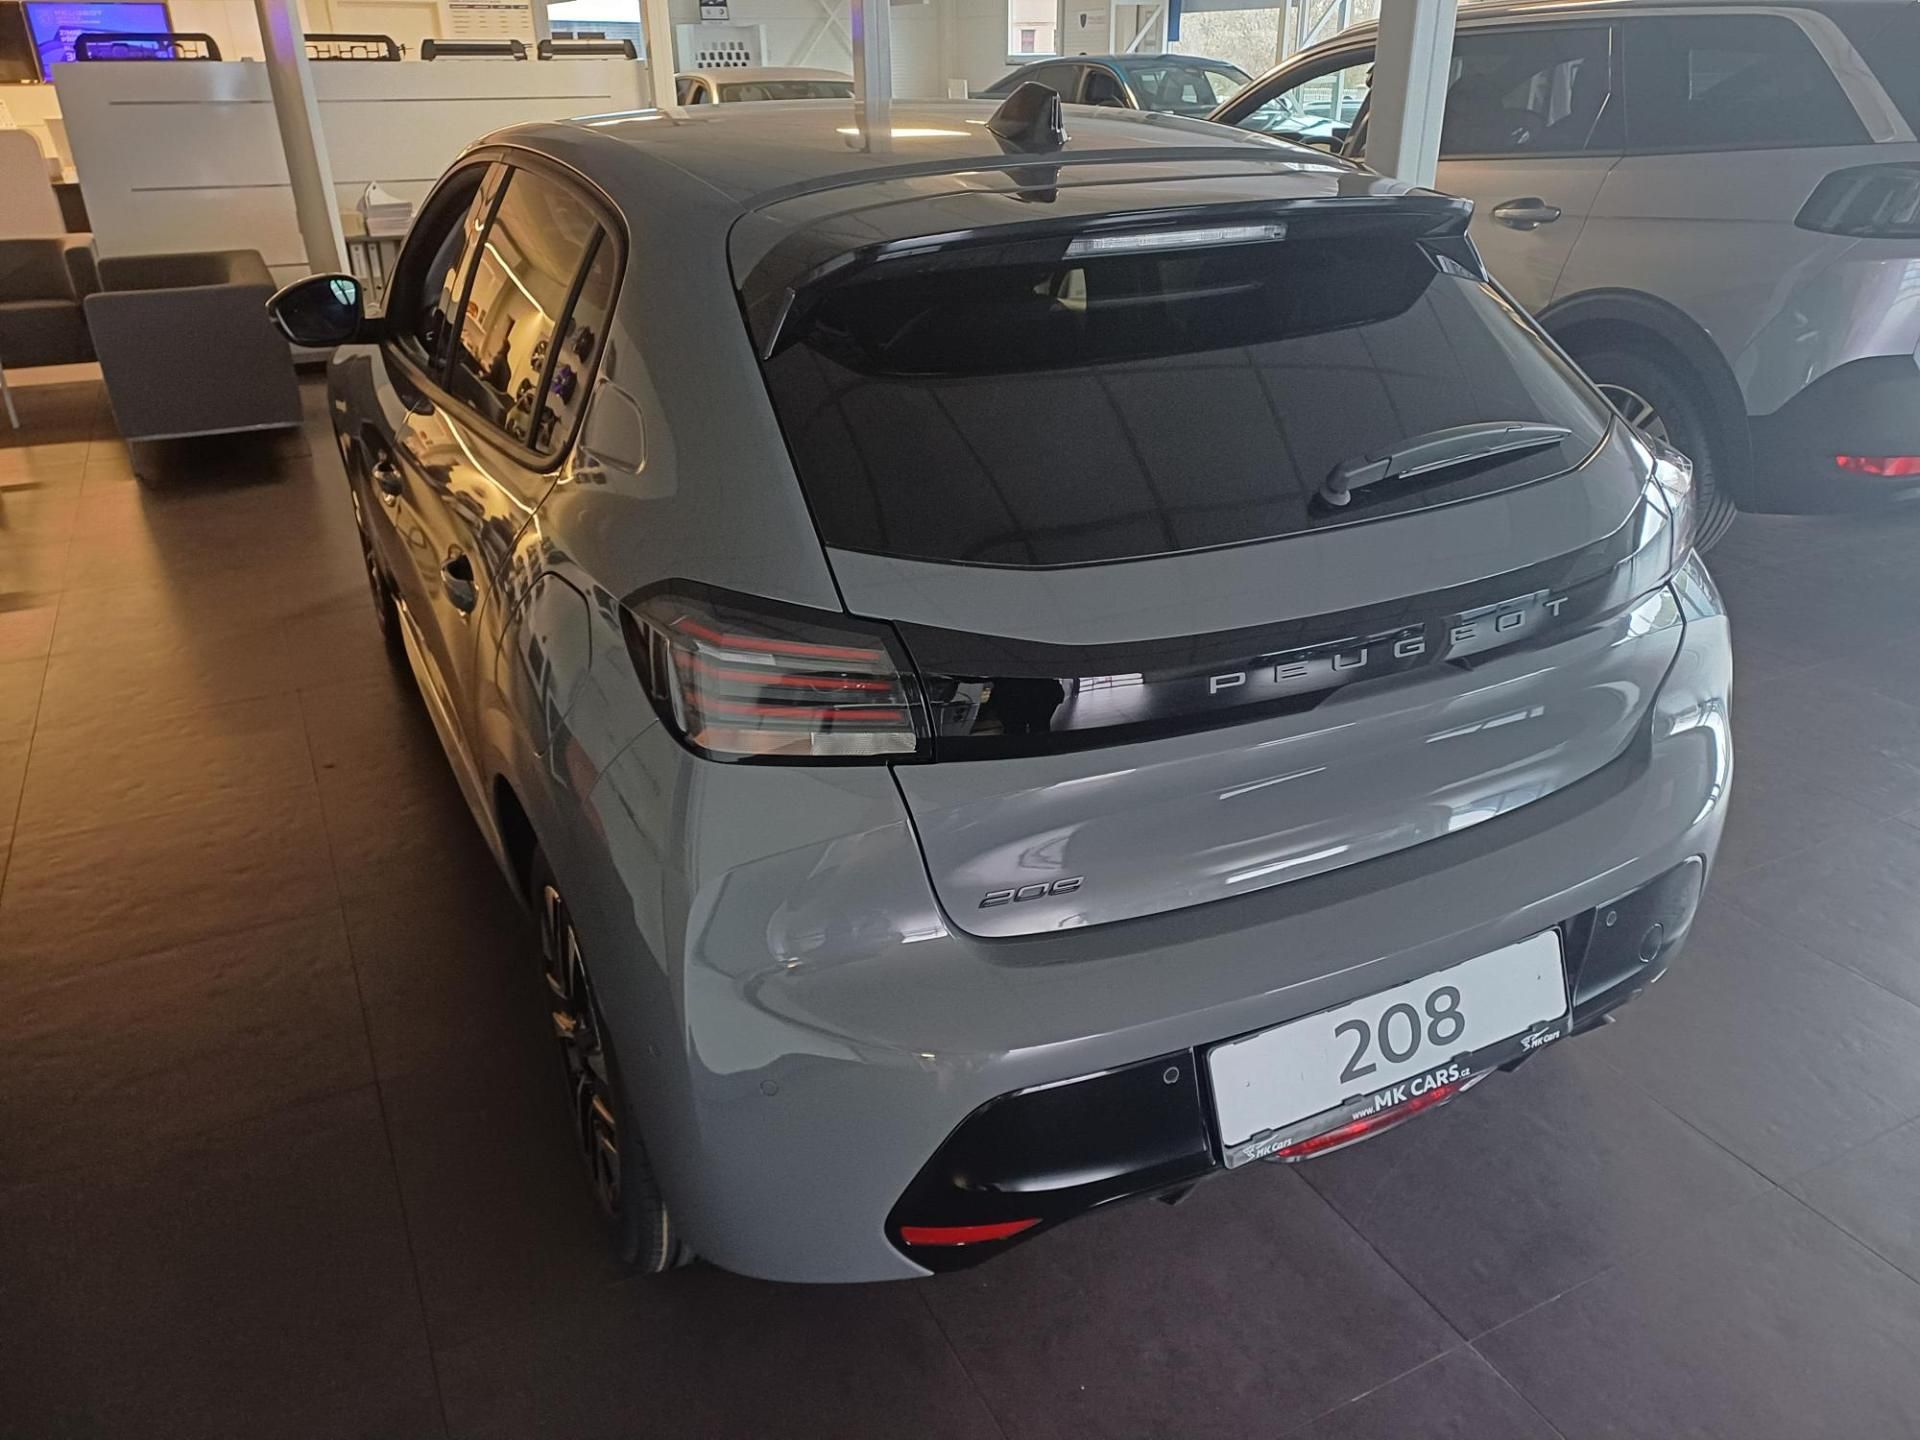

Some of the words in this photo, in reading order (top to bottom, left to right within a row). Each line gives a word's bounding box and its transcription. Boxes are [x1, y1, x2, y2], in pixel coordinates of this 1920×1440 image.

[1209, 597, 1568, 695] PEUGEOT
[978, 875, 1085, 909] 208
[1333, 985, 1466, 1084] 208
